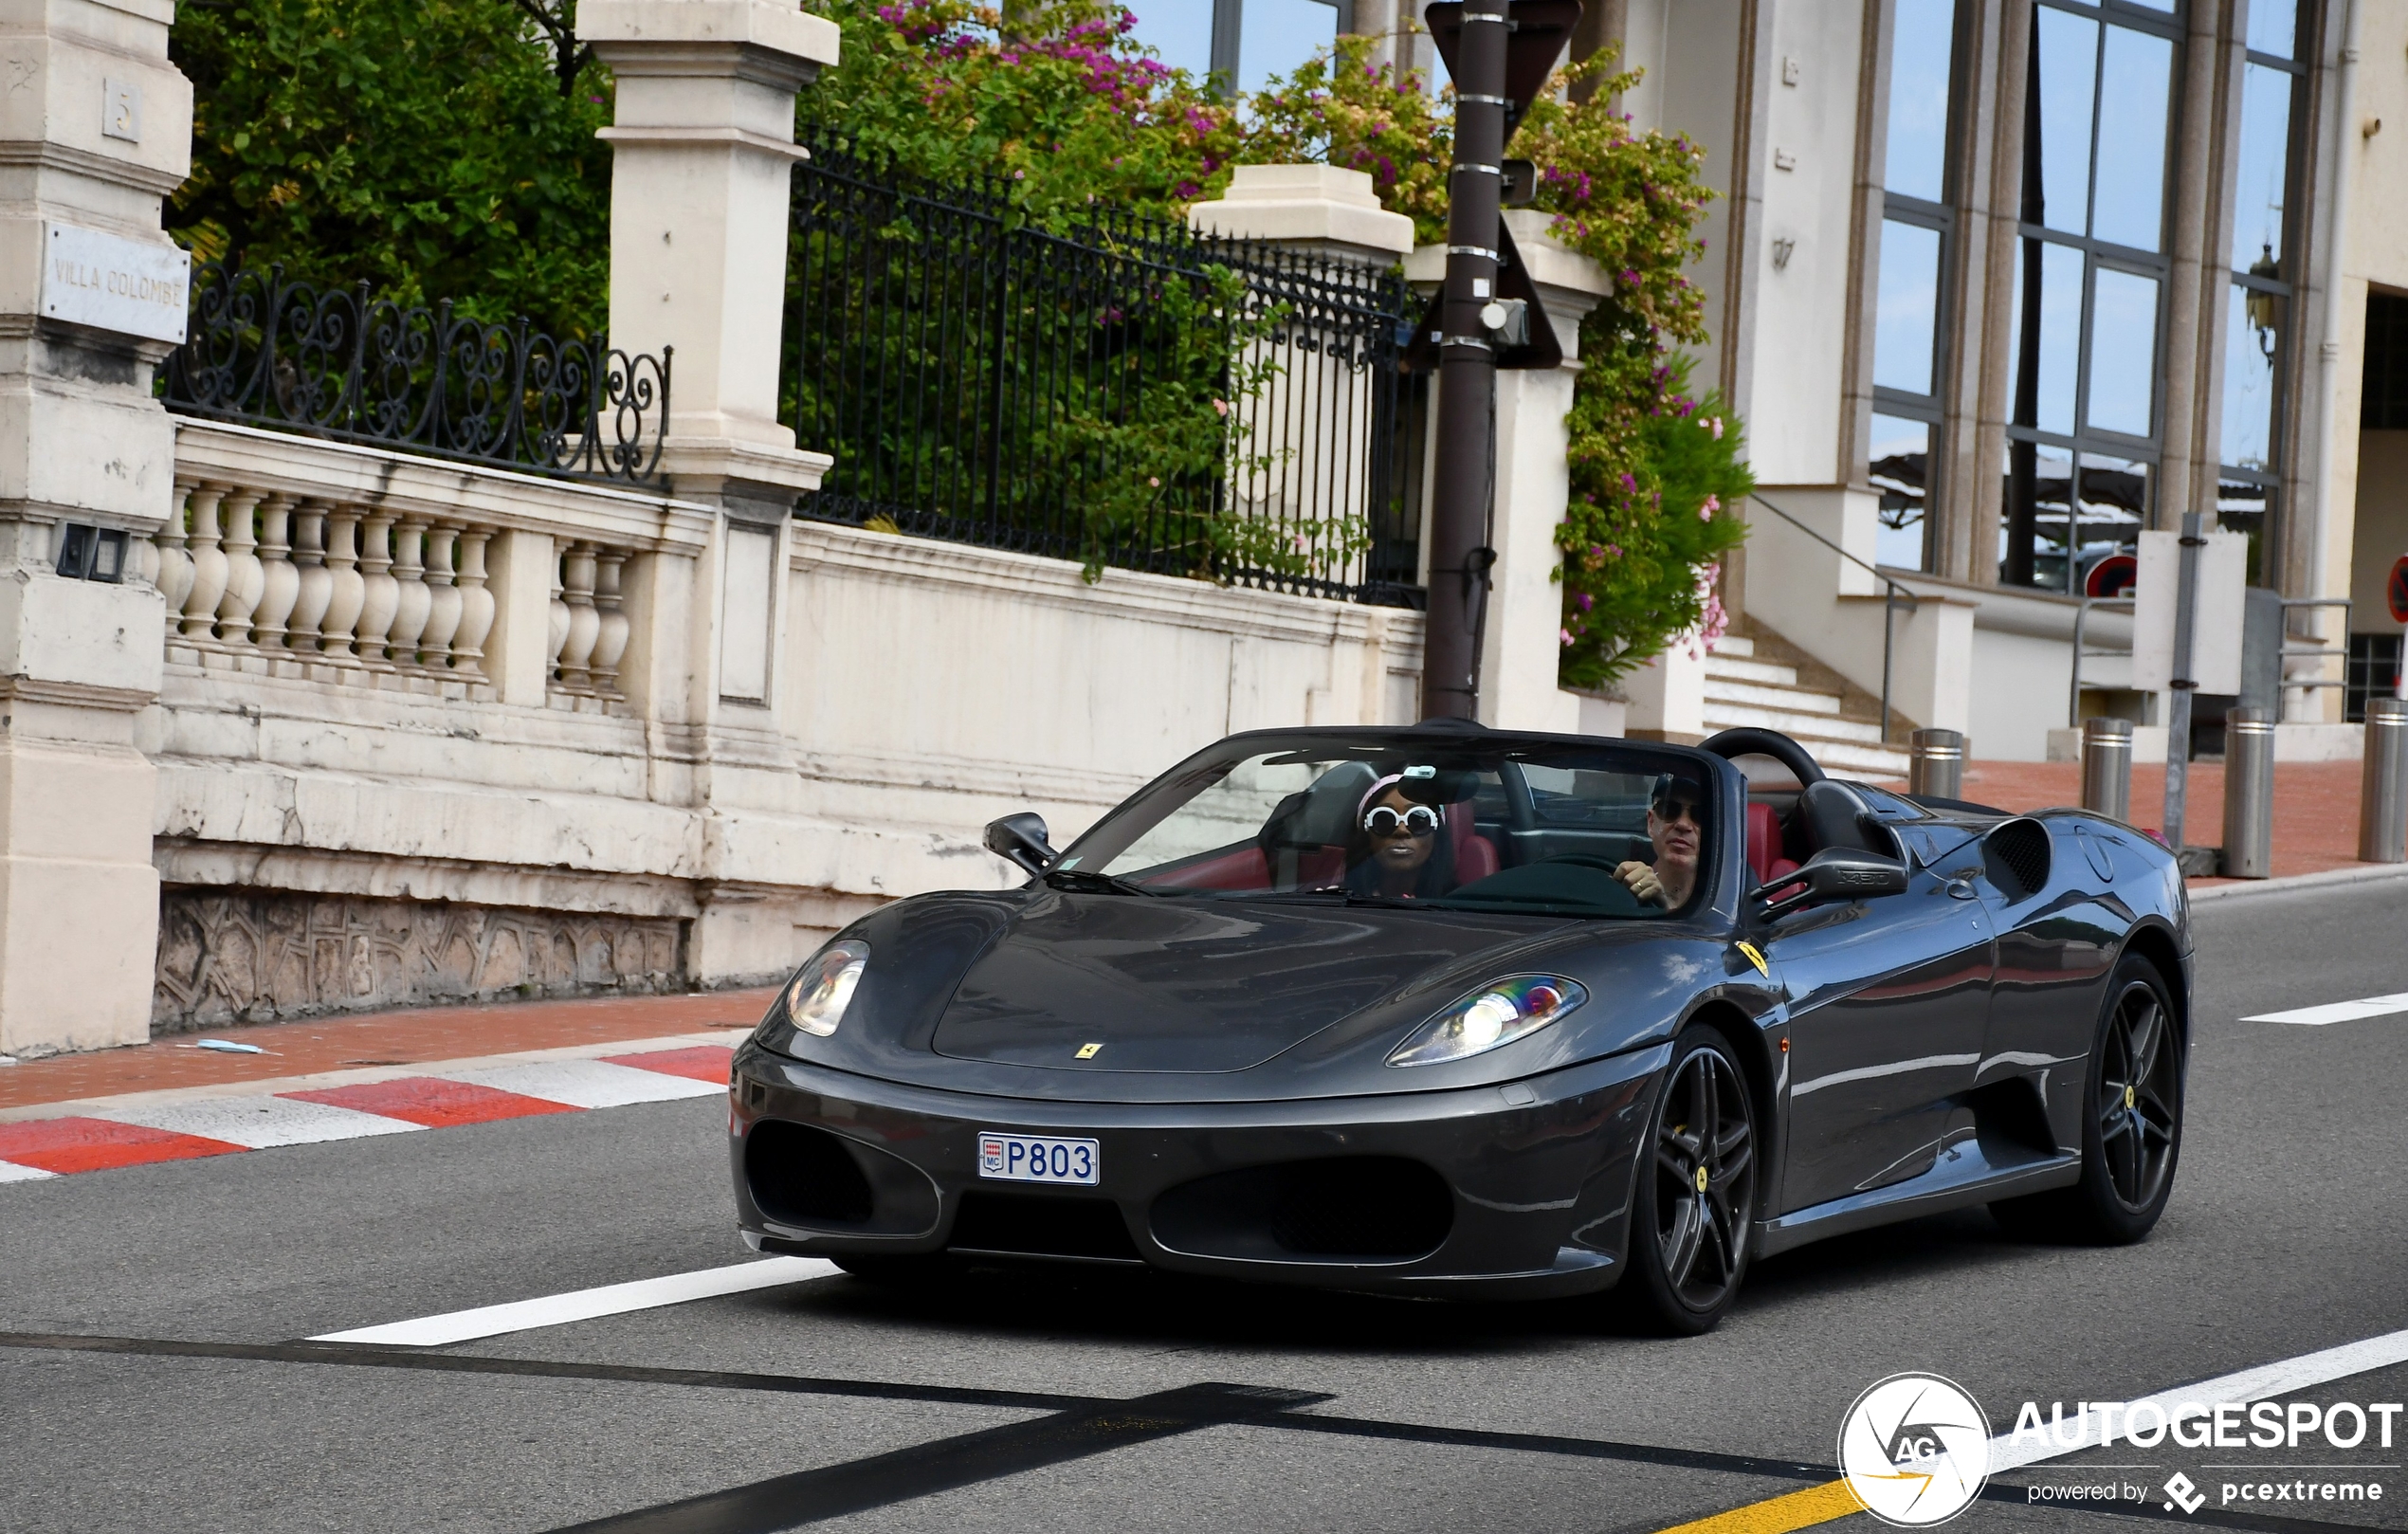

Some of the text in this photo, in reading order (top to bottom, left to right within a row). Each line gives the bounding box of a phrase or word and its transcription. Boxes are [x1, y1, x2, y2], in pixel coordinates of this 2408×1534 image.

[117, 93, 131, 131] 5
[55, 258, 182, 307] VILLA COLOMBE
[987, 1157, 999, 1166] MC
[1008, 1141, 1091, 1178] P803
